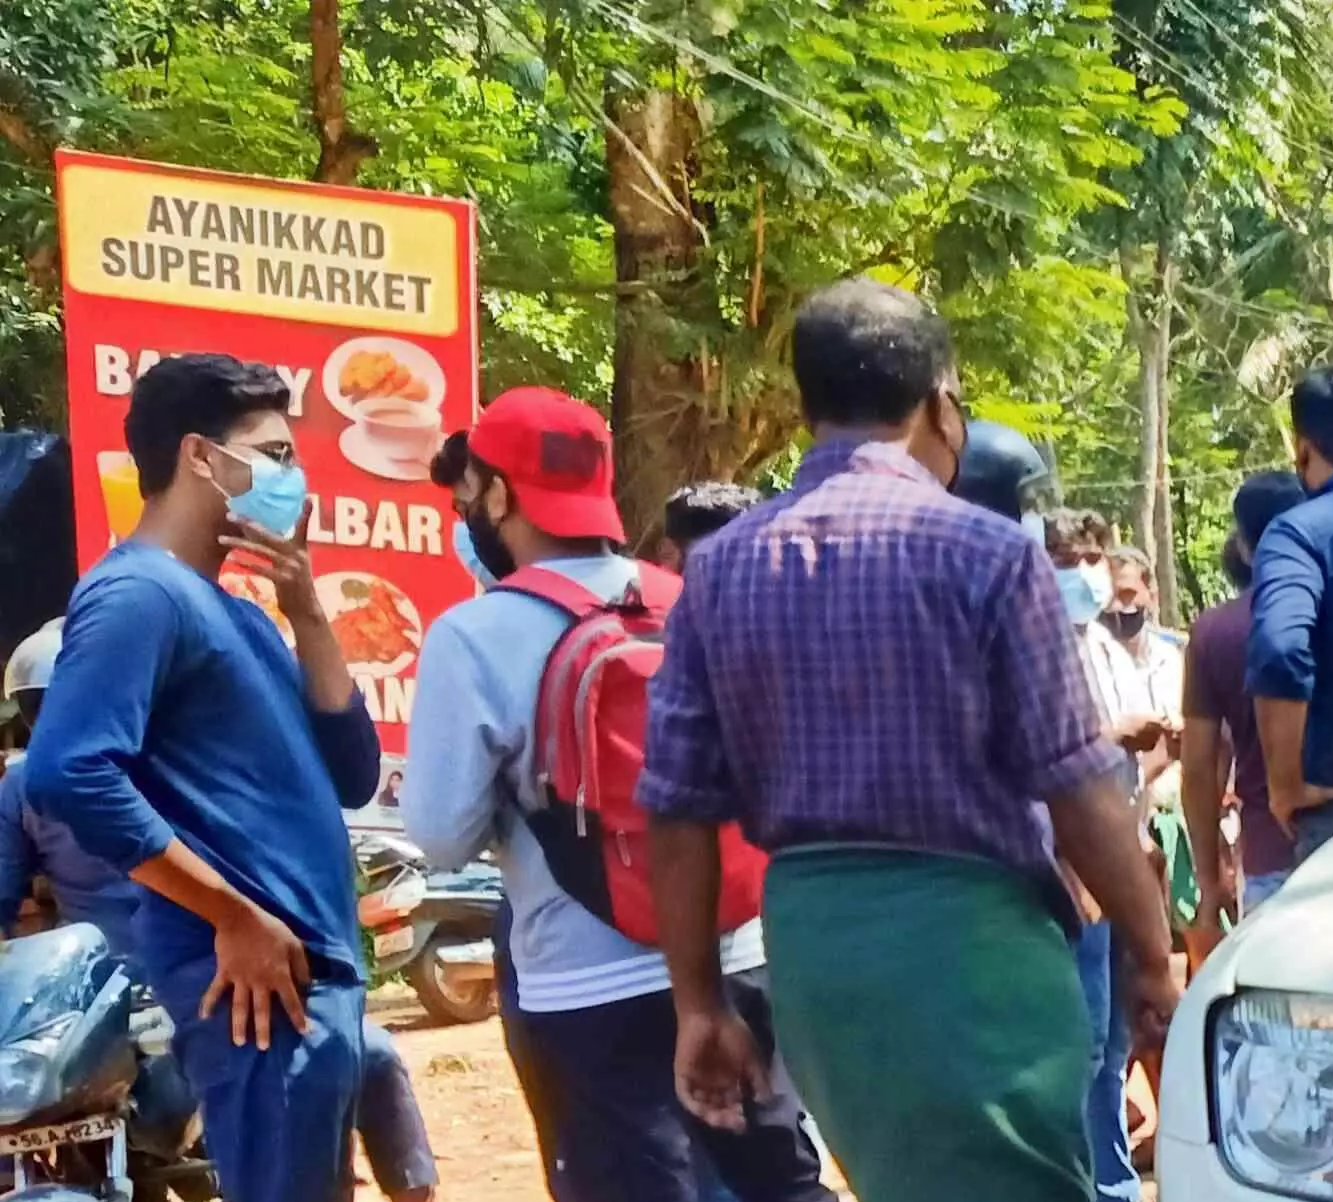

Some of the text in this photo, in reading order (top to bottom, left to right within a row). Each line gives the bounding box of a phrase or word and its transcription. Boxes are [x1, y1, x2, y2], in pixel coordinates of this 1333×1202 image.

[145, 194, 386, 260] AYANIKKAD
[101, 237, 432, 314] SUPER MARKET
